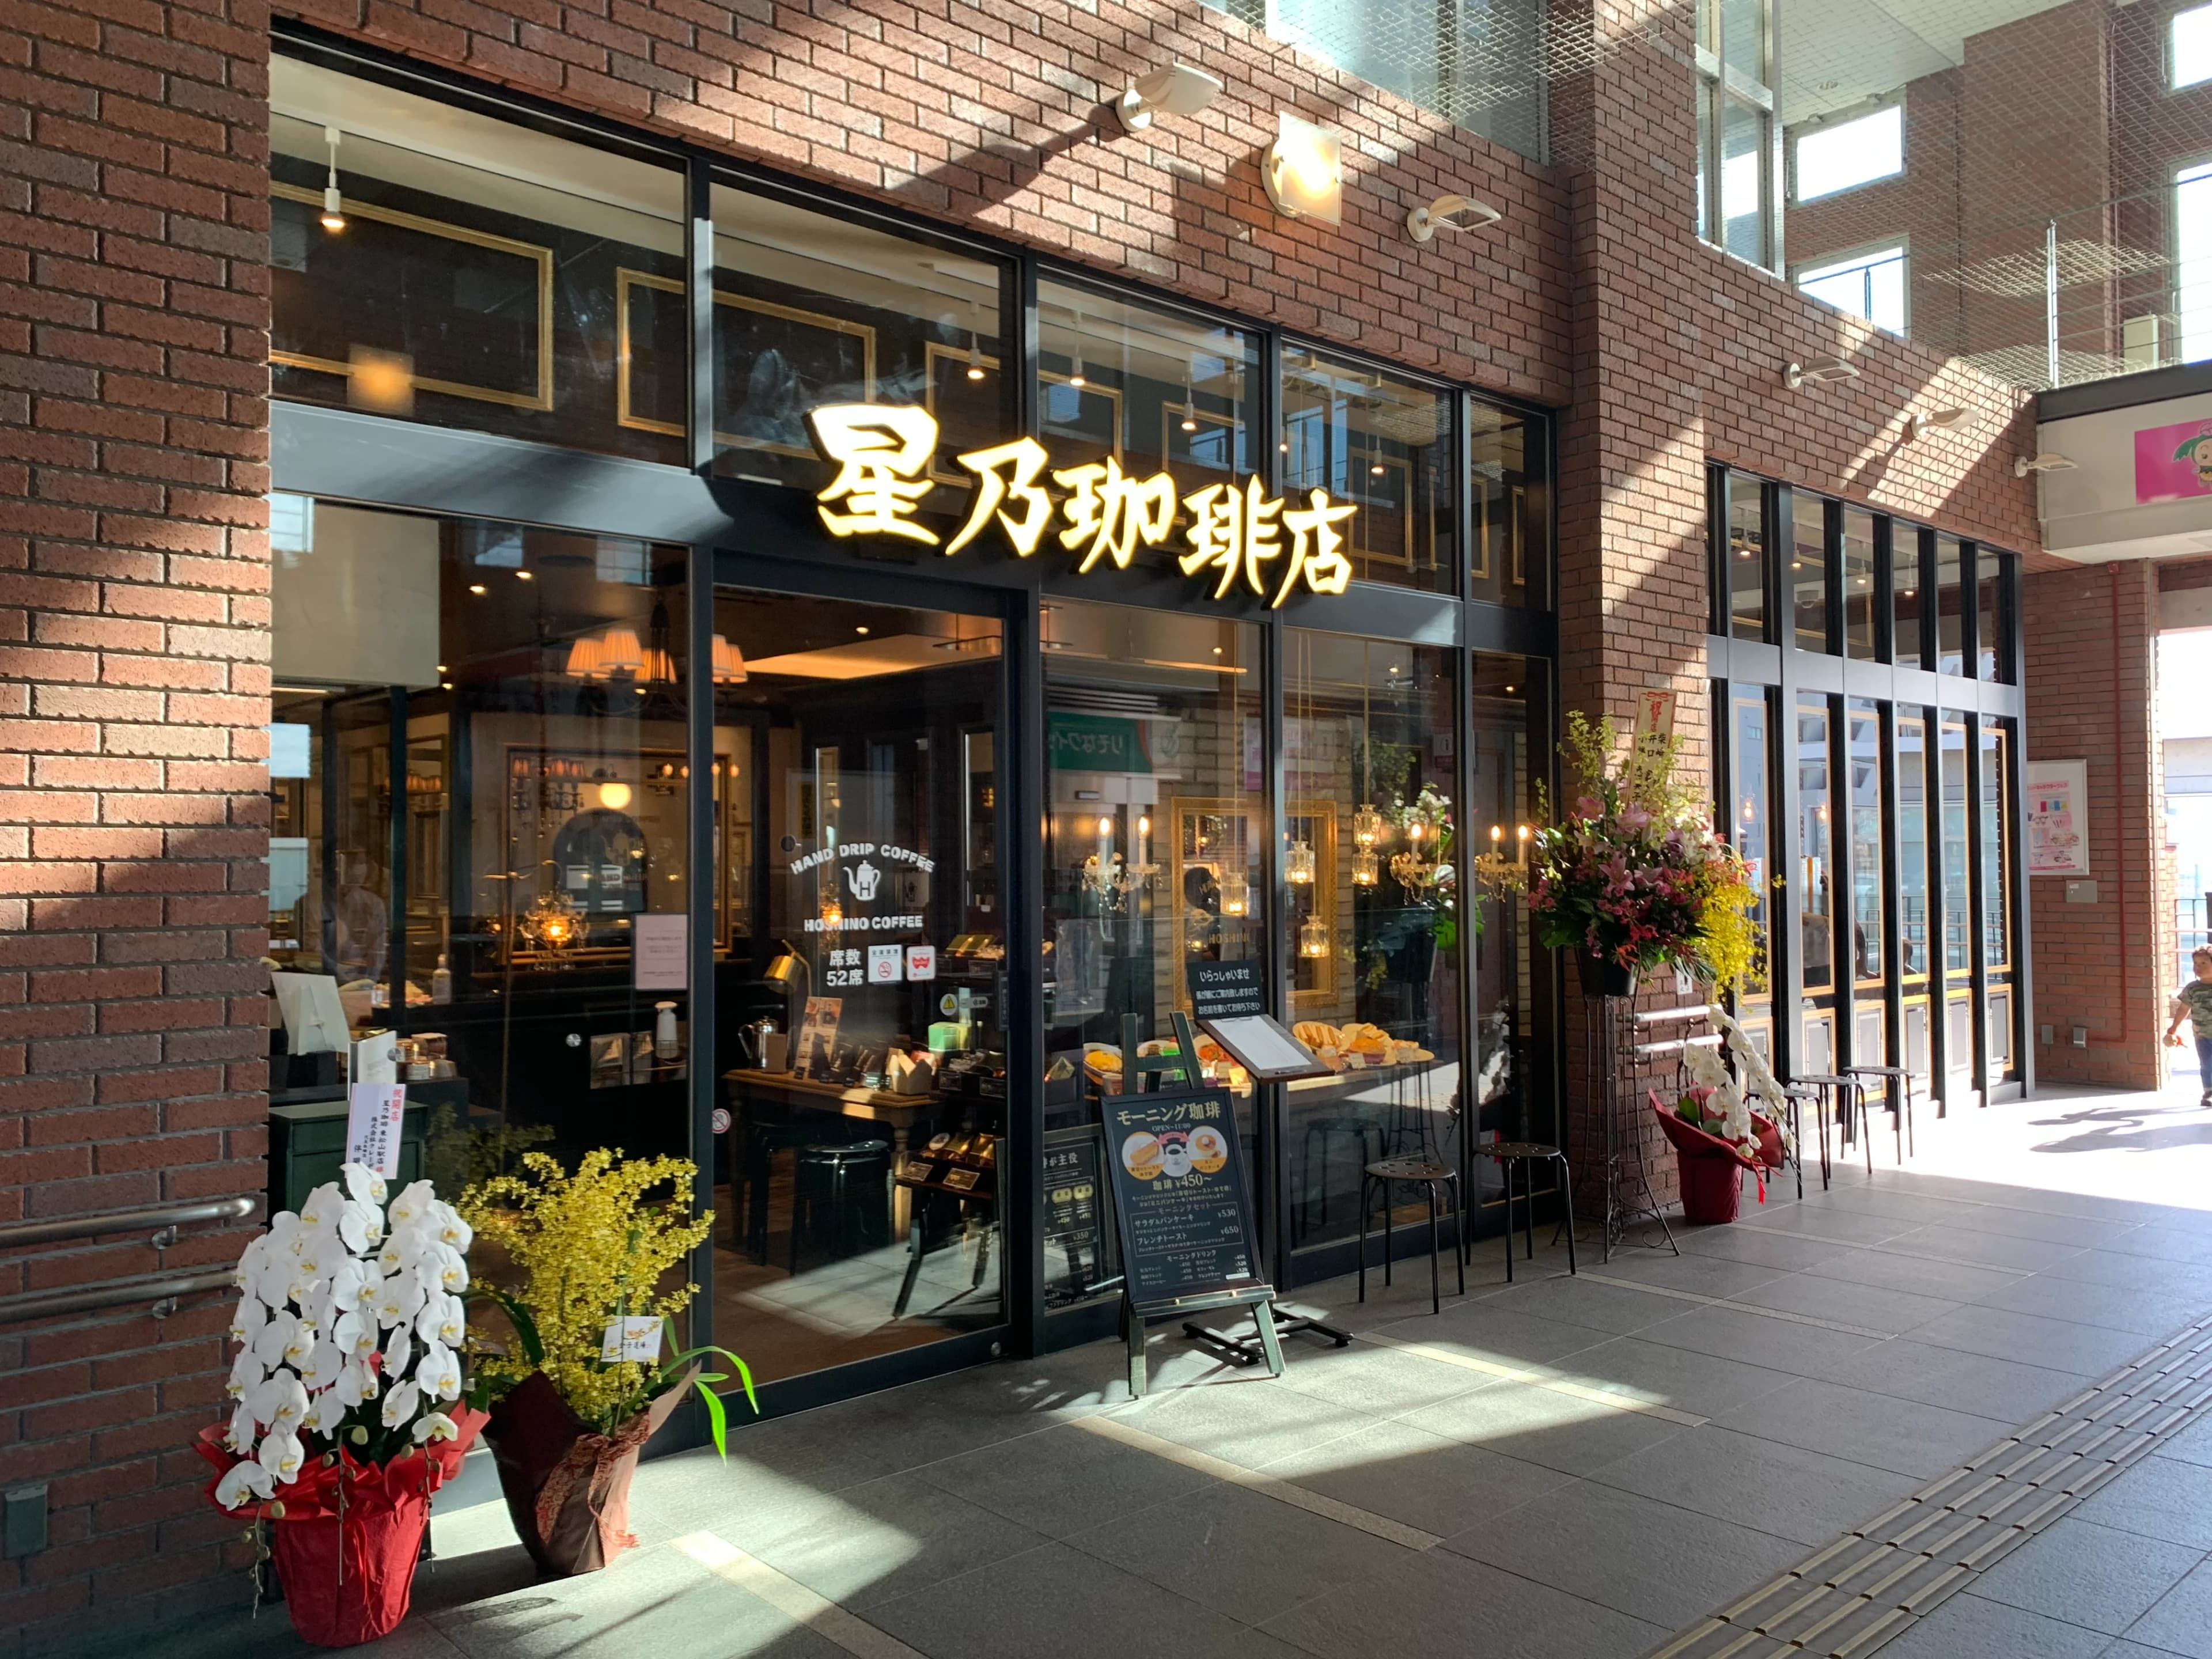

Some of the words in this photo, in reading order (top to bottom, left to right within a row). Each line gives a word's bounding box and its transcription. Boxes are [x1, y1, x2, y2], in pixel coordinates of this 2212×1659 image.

[810, 404, 1358, 609] 星乃珈琲店
[790, 847, 835, 875] HAND
[838, 843, 876, 857] DRIP
[880, 844, 937, 873] COFFEE
[871, 915, 923, 929] COFFEE
[829, 949, 862, 967] 席数
[826, 969, 864, 987] 52席
[1199, 968, 1250, 982] いらっしゃいませ
[1198, 1002, 1261, 1015] お名前を書いてお待ち下さい
[380, 1100, 390, 1127] 星乃珈琲
[390, 1089, 403, 1122] 祝開店
[1116, 1100, 1221, 1126] モーニング珈琲
[376, 1130, 388, 1165] 東松山駅店
[1152, 1179, 1173, 1191] 珈琲
[1158, 1202, 1212, 1215] モーニングセット
[1217, 1208, 1236, 1218] ¥530
[1137, 1232, 1188, 1246] フレンチトースト
[1220, 1225, 1239, 1236] ¥650
[1166, 1249, 1217, 1263] モーニングドリンク
